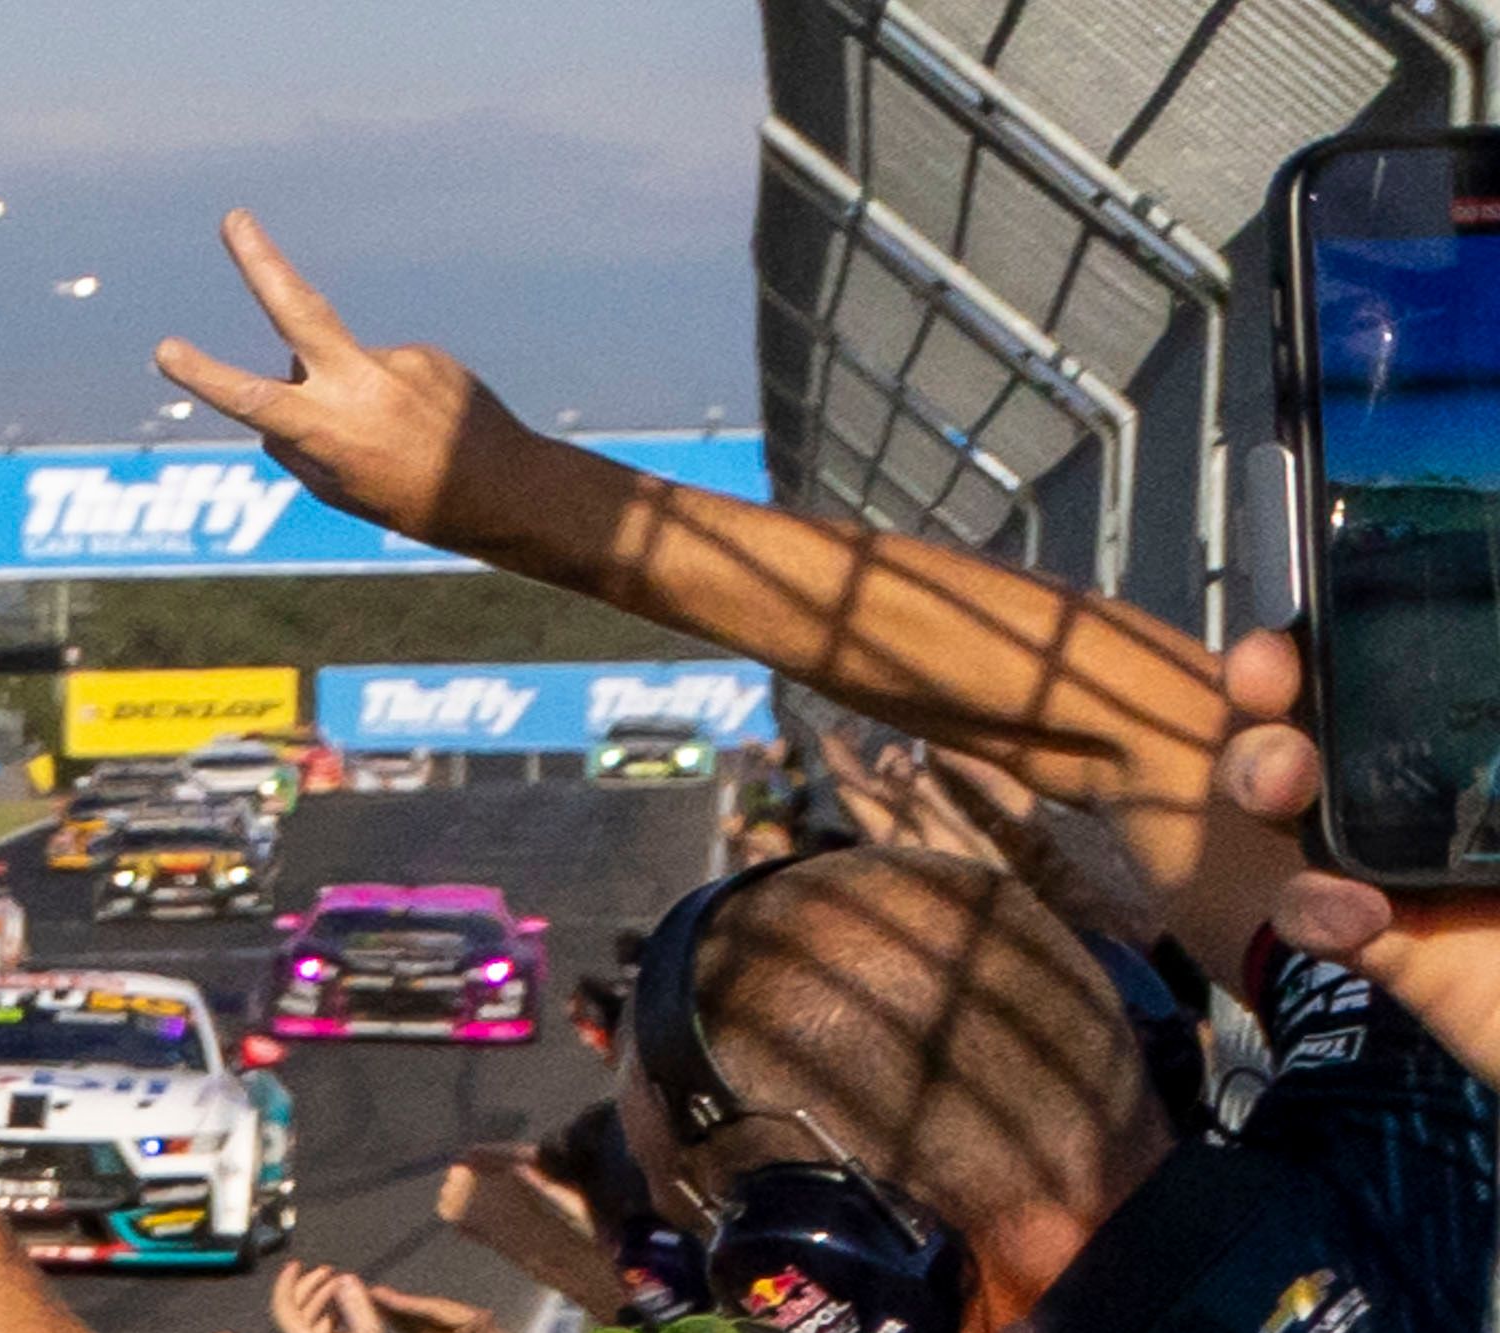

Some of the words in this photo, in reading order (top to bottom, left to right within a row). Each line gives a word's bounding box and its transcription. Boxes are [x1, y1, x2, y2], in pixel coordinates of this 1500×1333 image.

[22, 464, 304, 553] Thrifty
[112, 699, 286, 720] DUNLOP
[360, 677, 539, 737] Thrifty
[587, 674, 768, 735] Thrifty
